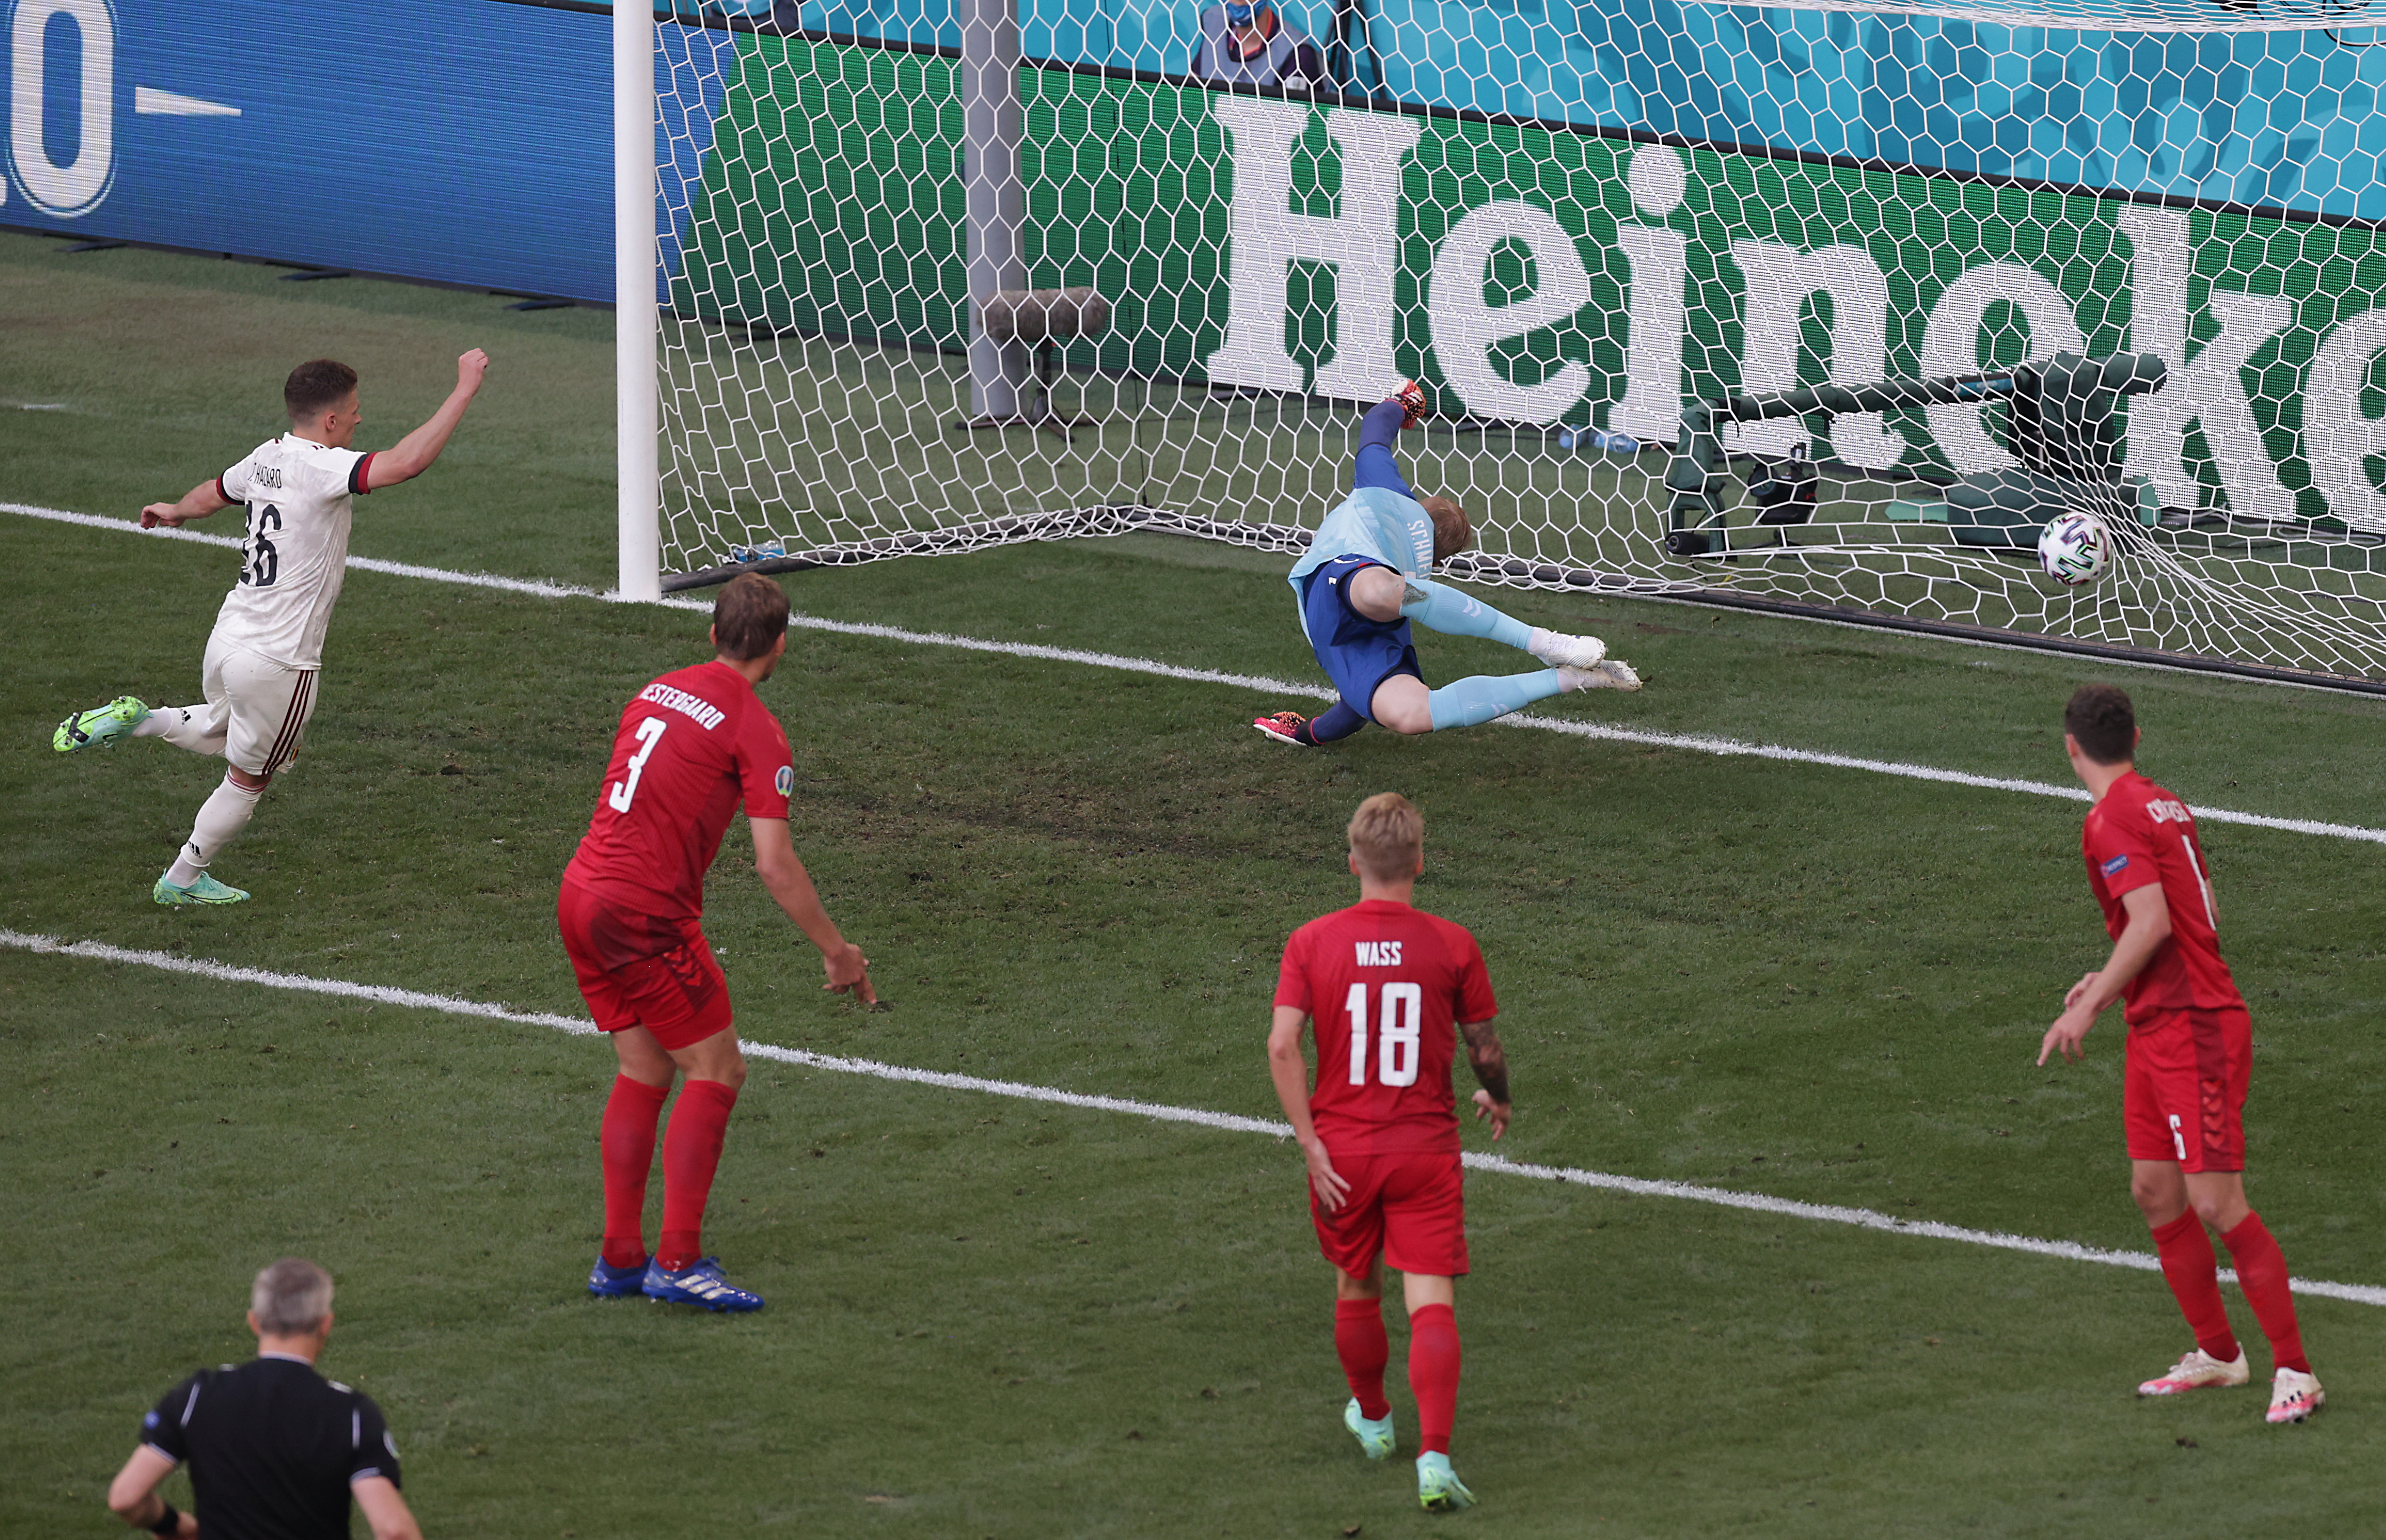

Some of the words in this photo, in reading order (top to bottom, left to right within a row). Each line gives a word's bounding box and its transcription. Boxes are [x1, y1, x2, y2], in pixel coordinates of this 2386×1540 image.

[254, 463, 282, 489] HAZARD
[1407, 520, 1433, 580] SCHMEI
[609, 716, 667, 813] 3
[1355, 941, 1402, 966] WASS
[1345, 982, 1421, 1087] 18
